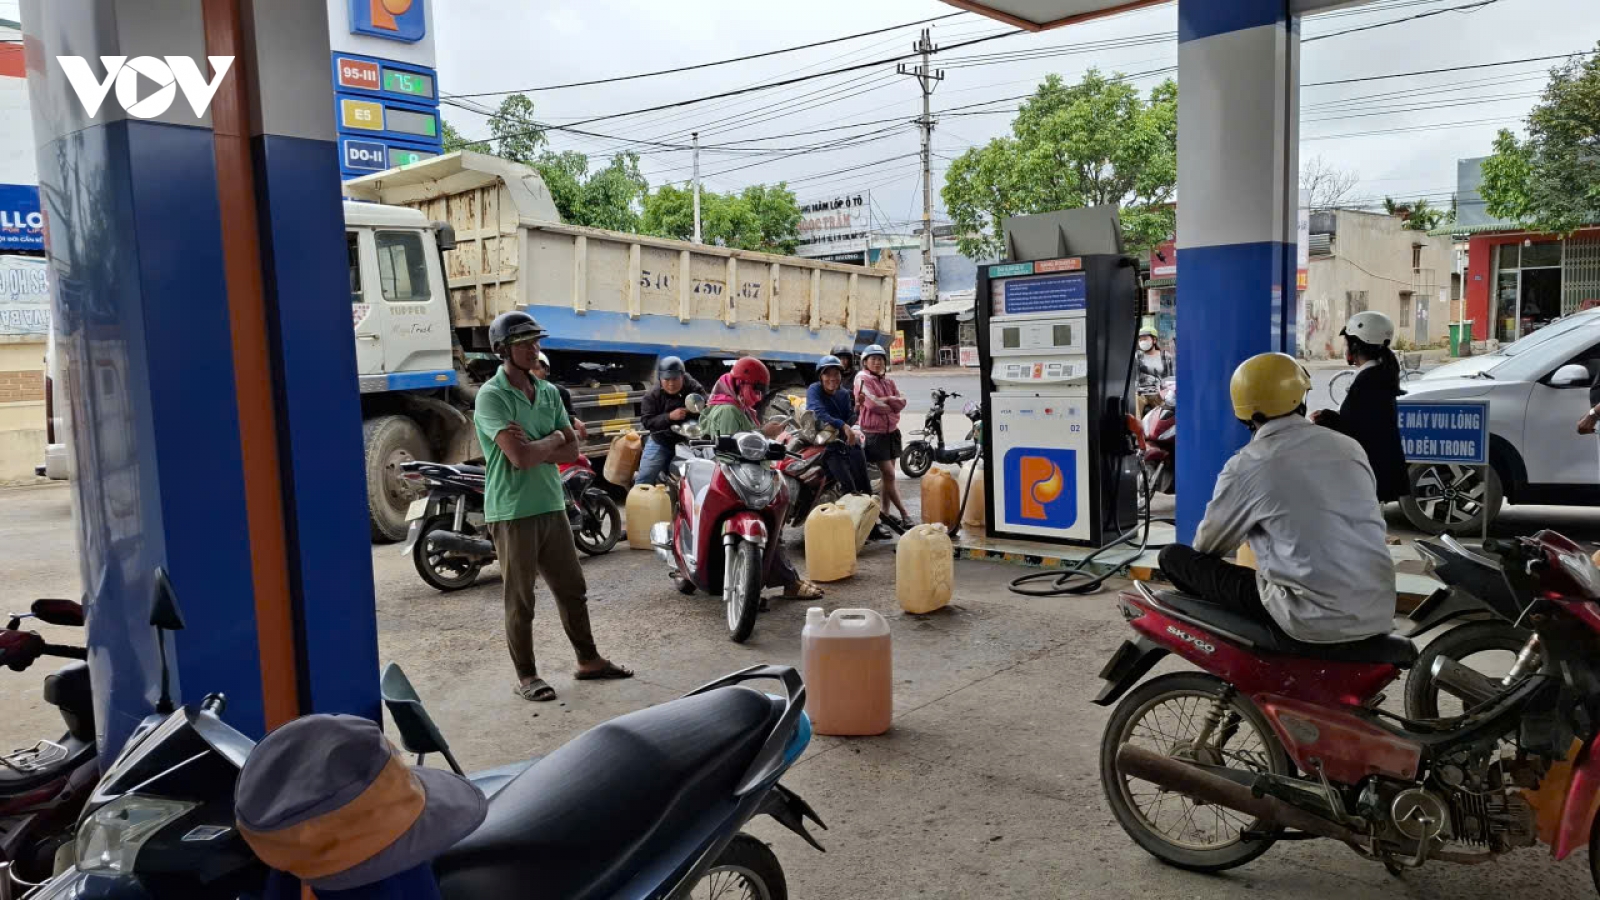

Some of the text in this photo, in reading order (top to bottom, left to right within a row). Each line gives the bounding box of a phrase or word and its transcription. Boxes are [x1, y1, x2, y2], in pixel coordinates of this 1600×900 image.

[343, 67, 376, 82] 95-III
[350, 148, 383, 163] DO-II
[1406, 409, 1430, 429] MÁY
[1431, 412, 1448, 429] VUI
[1451, 410, 1480, 430] LÒNG
[1070, 424, 1081, 433] 02
[1416, 436, 1438, 456] BÊN
[1440, 439, 1476, 457] TRONG
